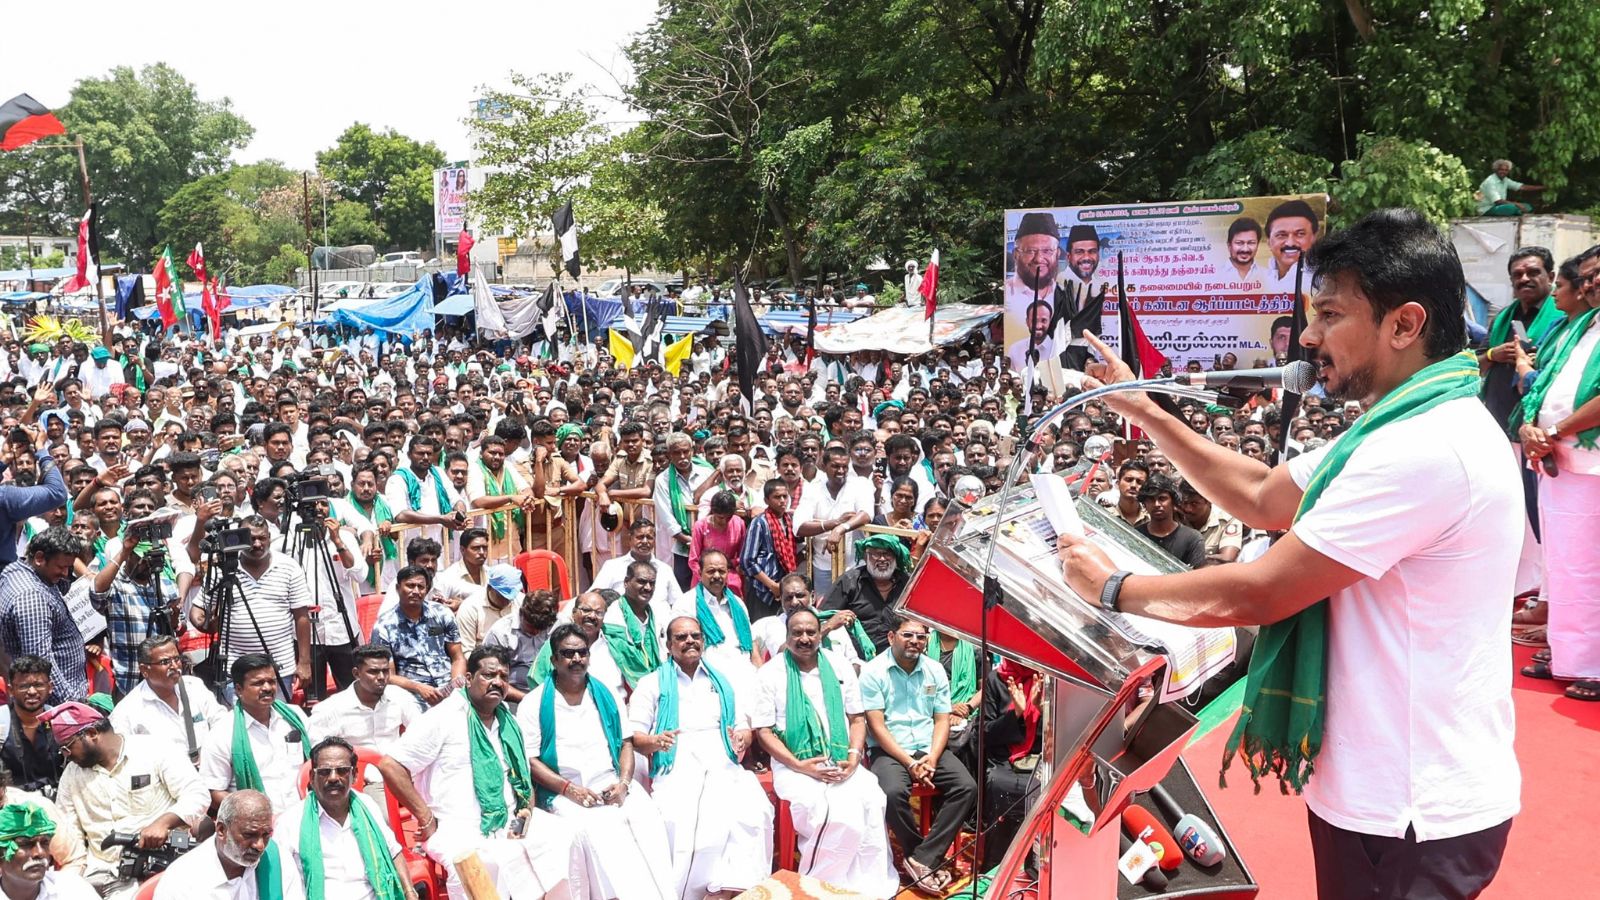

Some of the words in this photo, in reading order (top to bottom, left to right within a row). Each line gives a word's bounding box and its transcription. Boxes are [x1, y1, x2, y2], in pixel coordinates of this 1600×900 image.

[1142, 253, 1171, 265] ஆகாத
[1131, 265, 1168, 278] கண்டித்து
[1170, 263, 1216, 276] தஞ்சையில்
[1139, 280, 1202, 293] தலைமையில்
[1204, 279, 1262, 292] நடைபெறும்
[1143, 296, 1189, 312] கண்டன
[1192, 293, 1296, 314] ஆர்ப்பாட்டத்திற்
